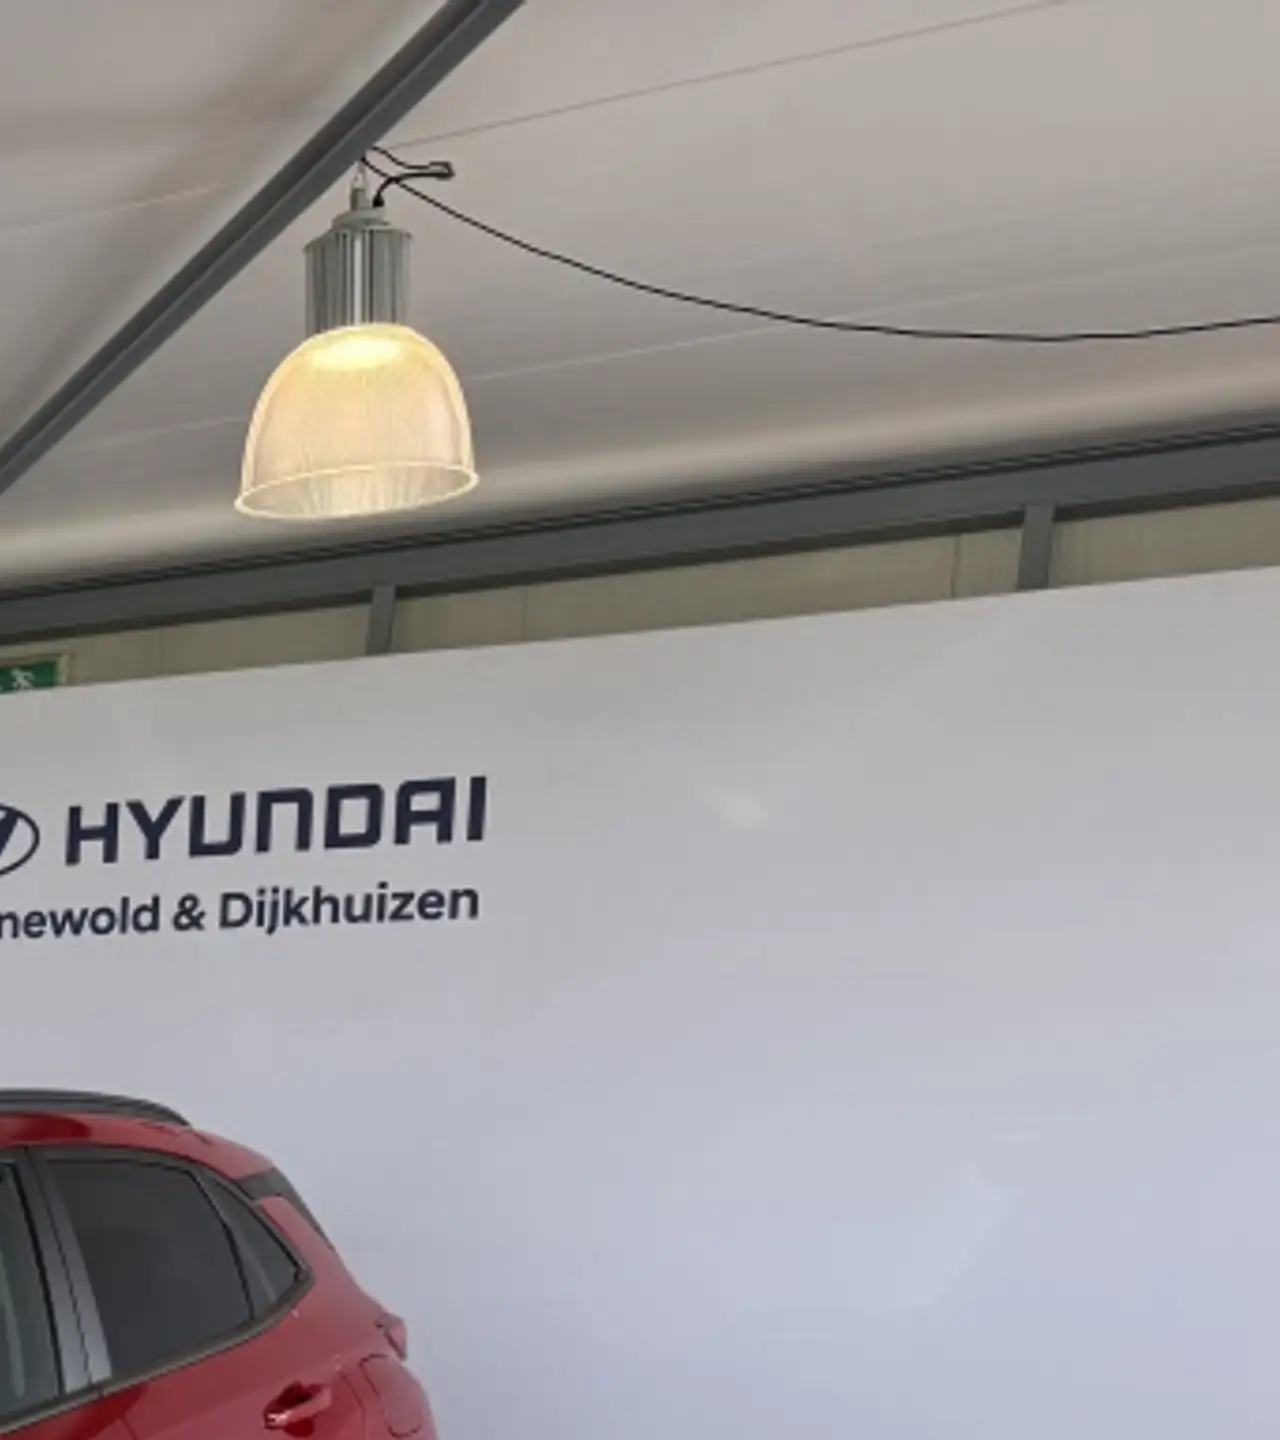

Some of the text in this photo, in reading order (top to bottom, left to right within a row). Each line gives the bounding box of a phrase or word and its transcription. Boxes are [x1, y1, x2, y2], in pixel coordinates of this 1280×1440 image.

[65, 776, 488, 866] HYUNDAI
[172, 894, 207, 931] &
[219, 882, 480, 935] Dijkhuizen
